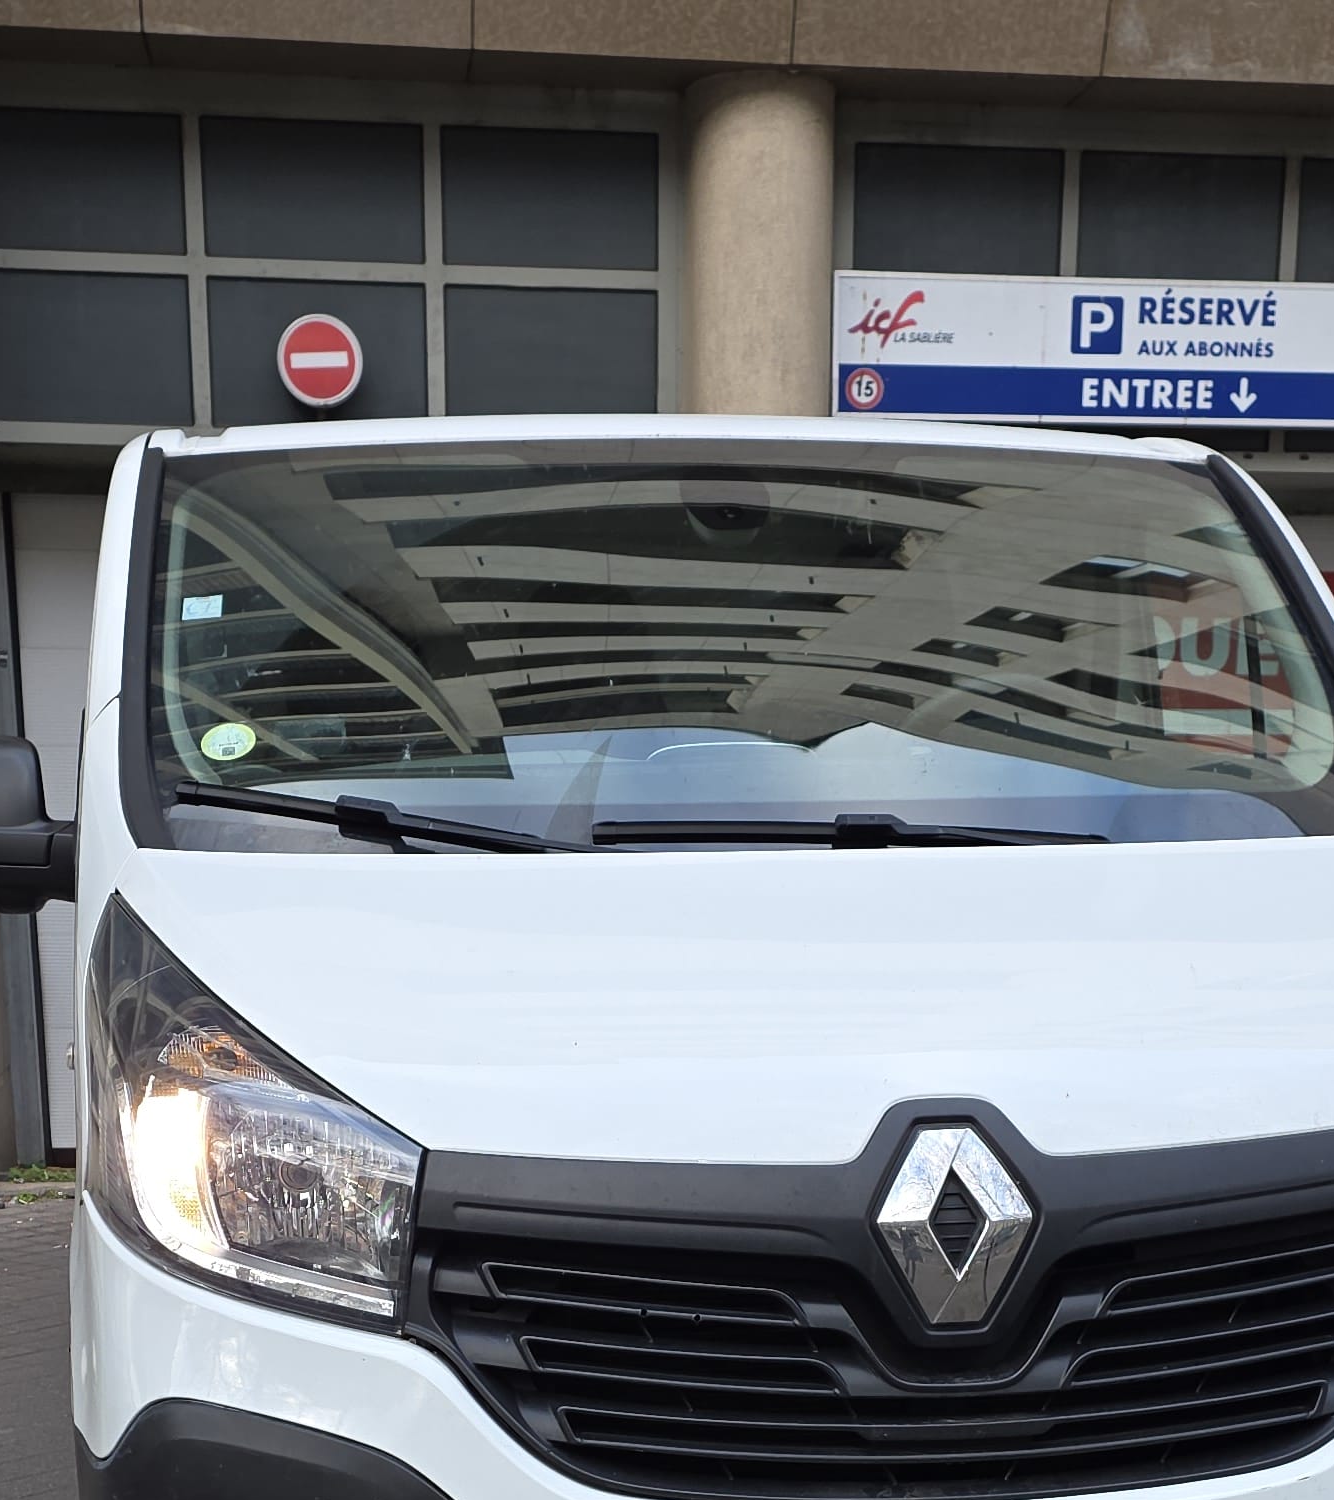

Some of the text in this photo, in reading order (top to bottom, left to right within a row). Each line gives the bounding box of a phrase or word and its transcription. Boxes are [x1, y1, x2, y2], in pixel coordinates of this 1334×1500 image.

[847, 289, 926, 349] icf
[1137, 287, 1278, 327] RÉSERVÉ
[893, 331, 907, 343] LA
[1079, 301, 1115, 349] P
[1137, 338, 1275, 358] AUX ABONNÉS
[855, 380, 875, 398] 15
[1081, 376, 1215, 411] ENTREE
